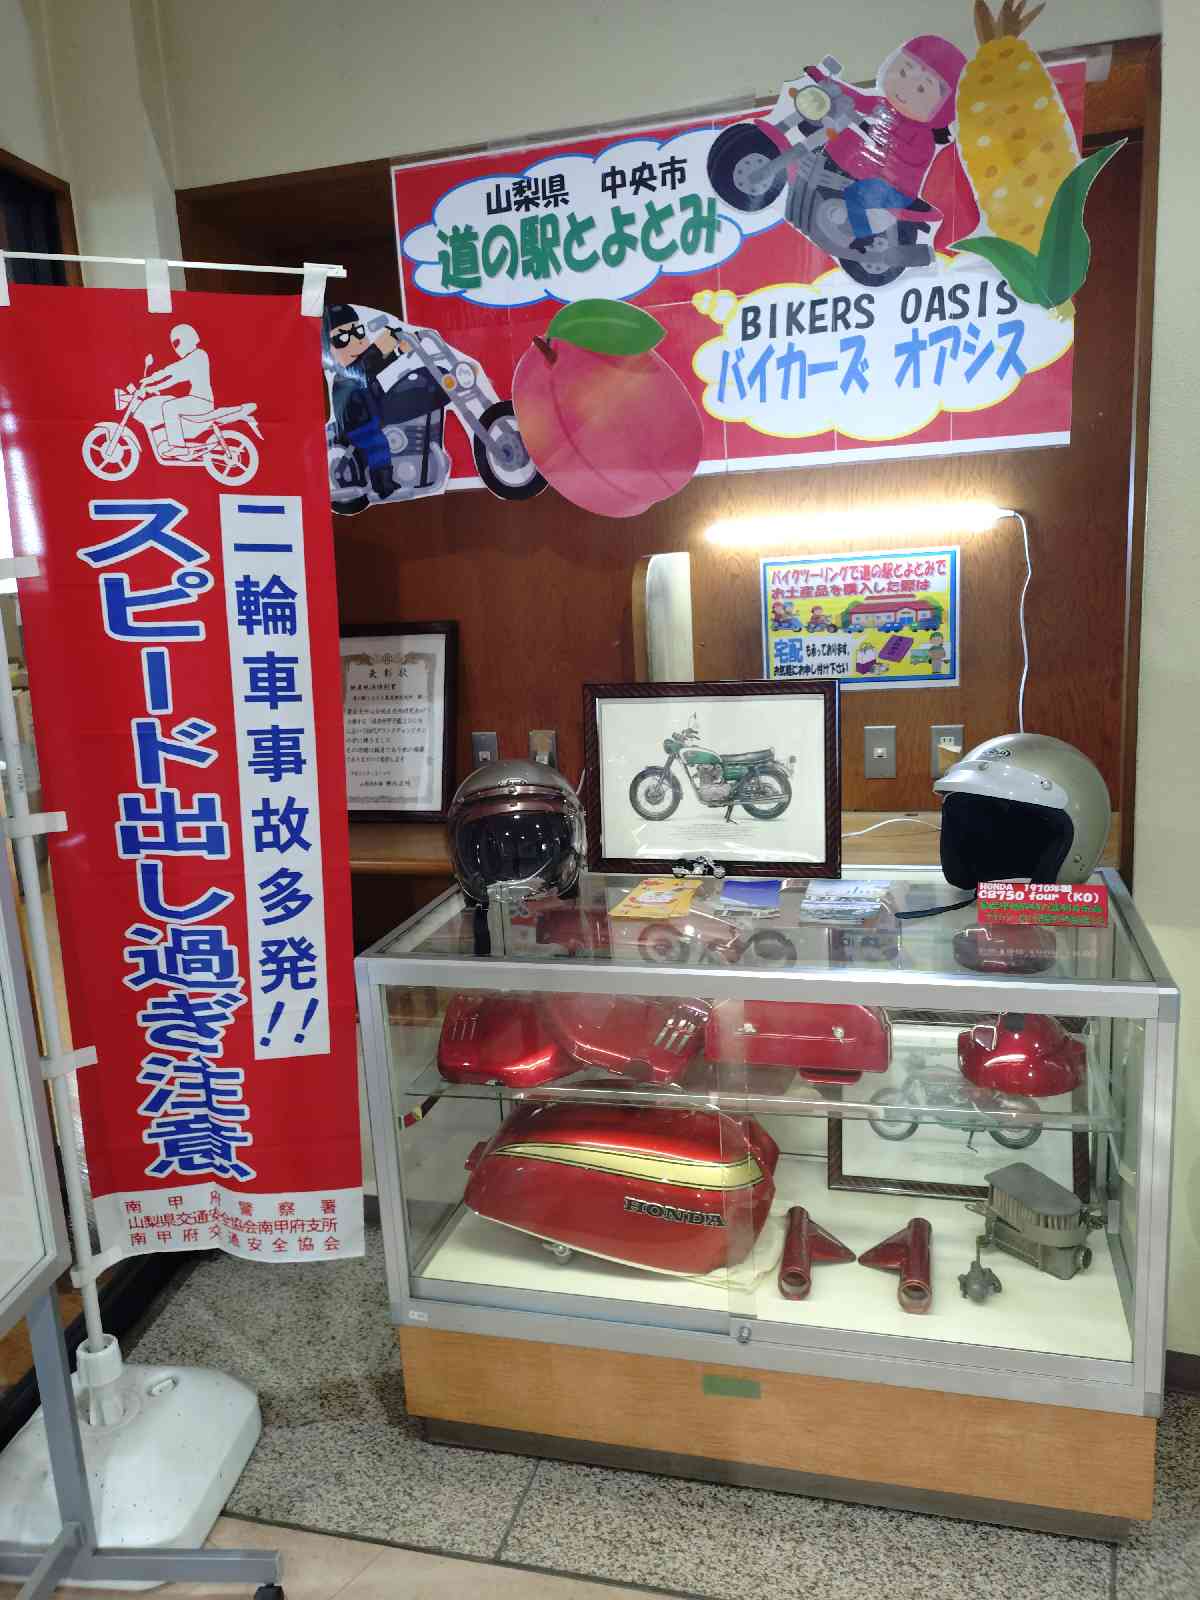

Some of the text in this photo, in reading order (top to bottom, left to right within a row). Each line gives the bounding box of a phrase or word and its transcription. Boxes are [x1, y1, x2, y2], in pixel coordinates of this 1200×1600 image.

[486, 156, 687, 215] 山梨県 中央市
[437, 193, 721, 290] 道の駅とよとみ
[741, 280, 1018, 341] BIKERS OASIS
[718, 320, 1027, 403] バイカーズ オアシス
[774, 637, 803, 663] 宅配
[78, 500, 255, 1180] スピード出し過ぎ注意
[978, 889, 1025, 901] CB750
[979, 882, 1014, 891] HONDA
[624, 1196, 728, 1228] HONDA
